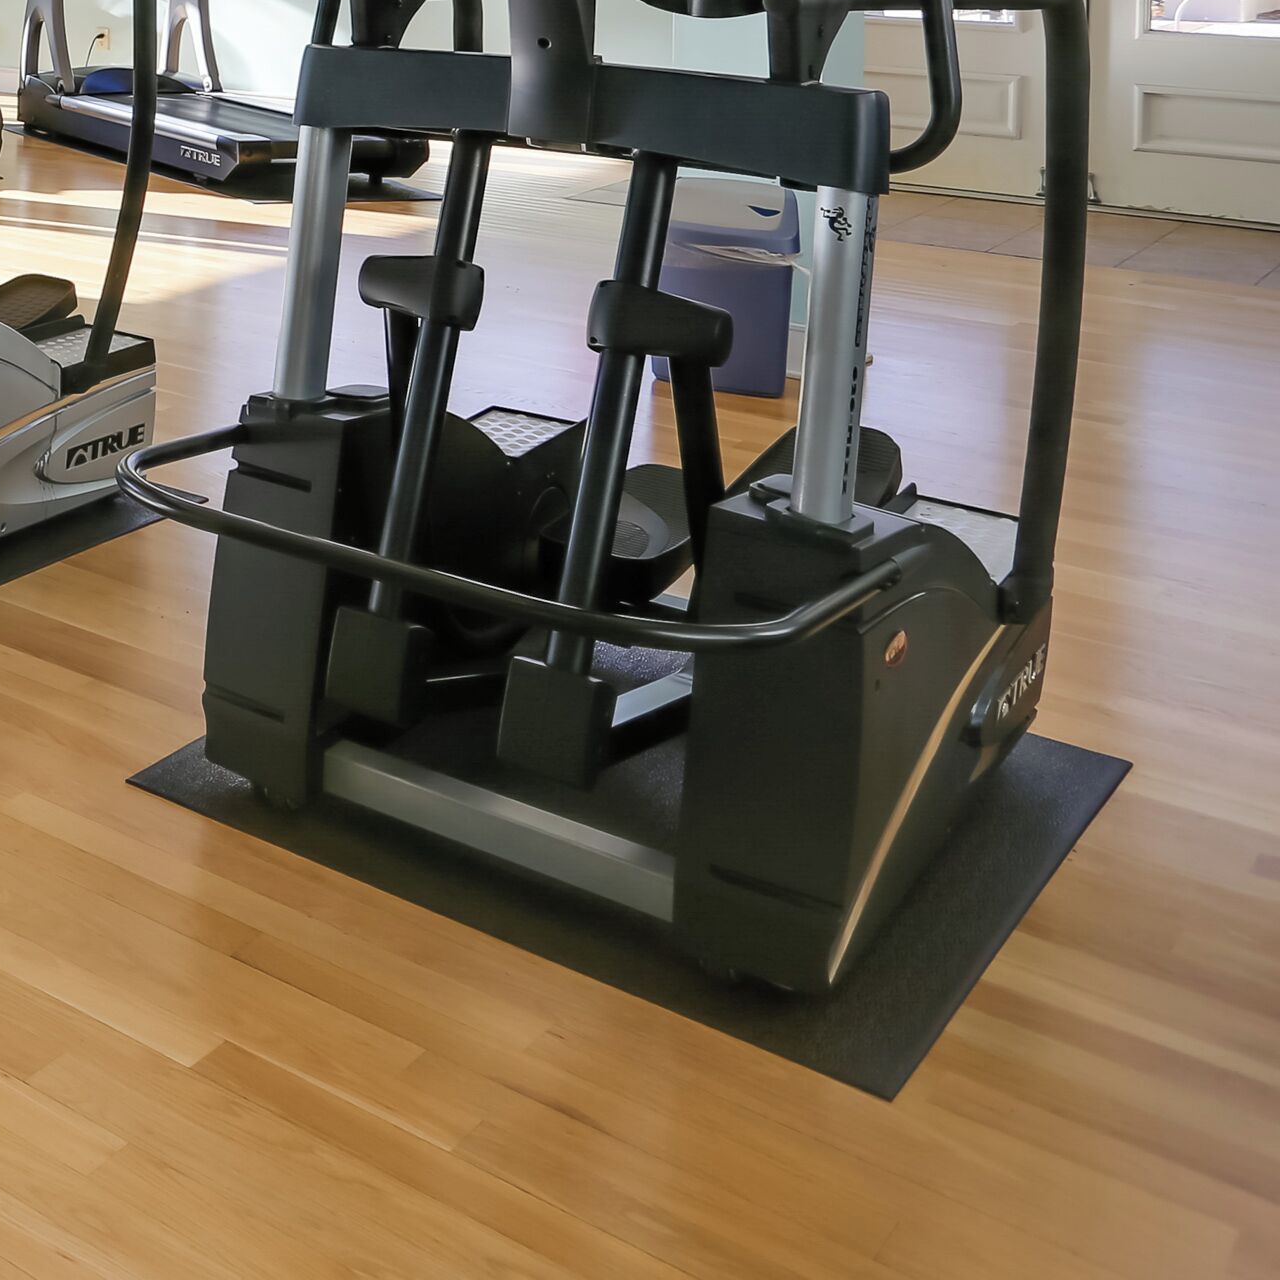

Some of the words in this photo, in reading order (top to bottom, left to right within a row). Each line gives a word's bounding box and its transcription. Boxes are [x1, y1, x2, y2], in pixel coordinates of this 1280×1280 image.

[190, 148, 220, 167] TRUE
[90, 423, 145, 461] TRUE
[1011, 643, 1046, 705] TRUE
